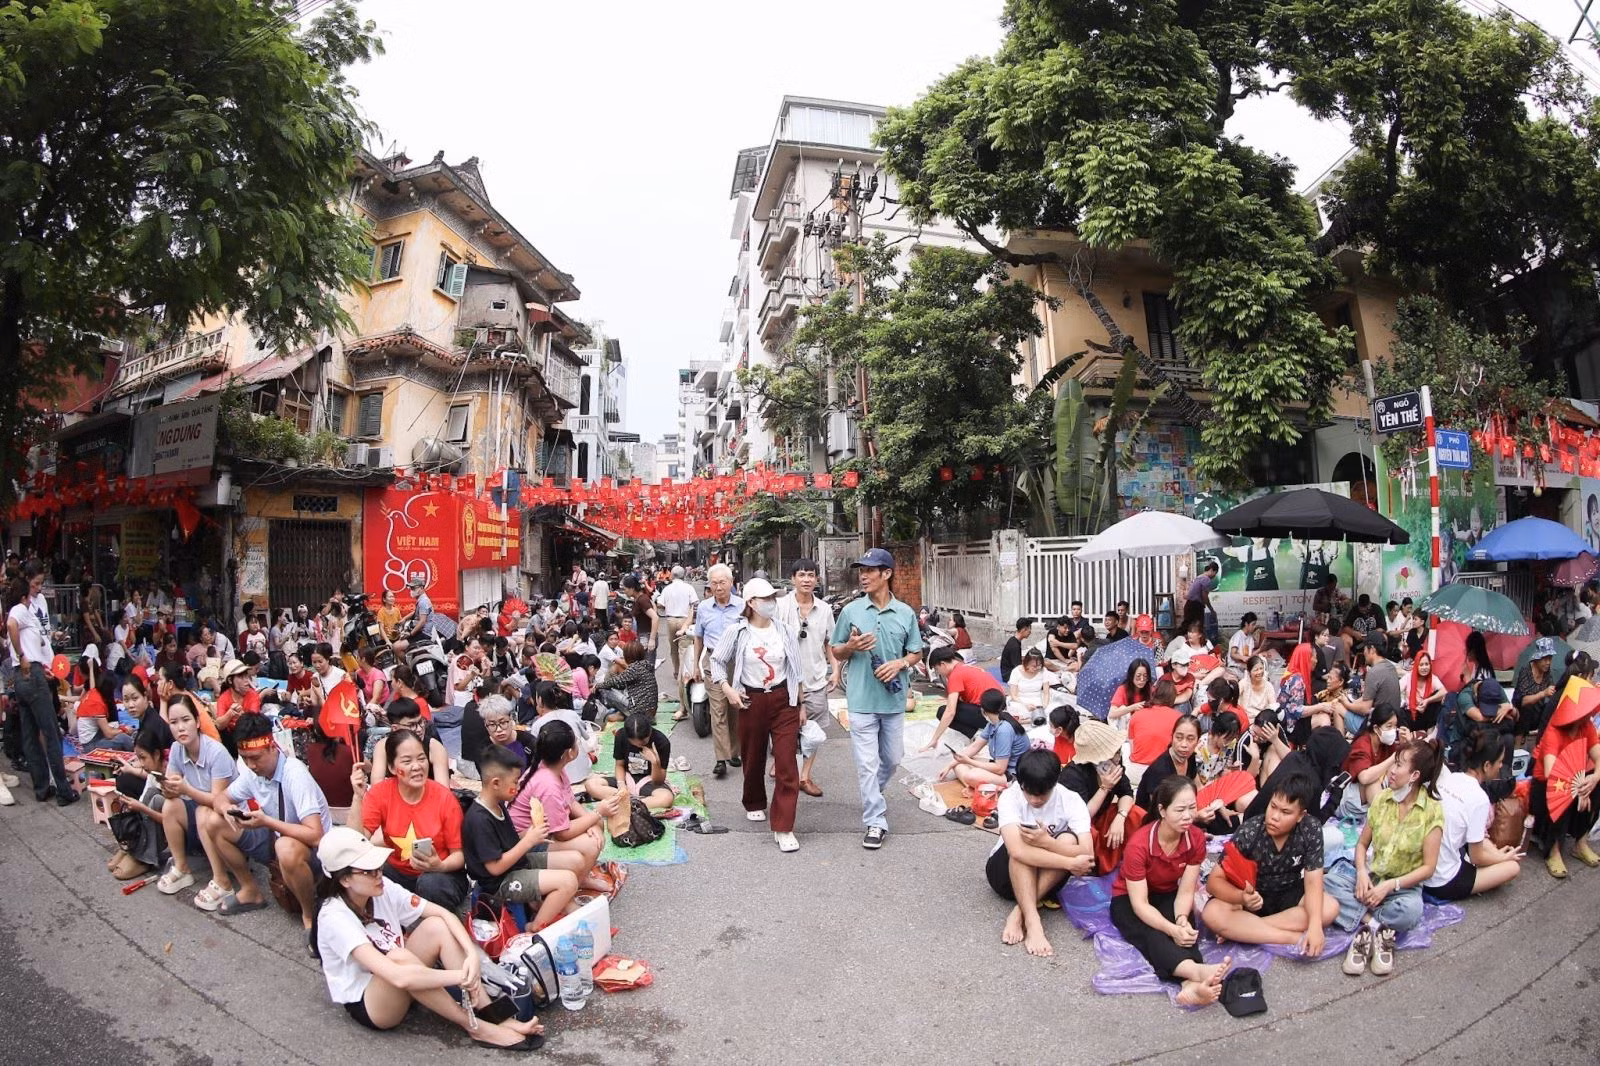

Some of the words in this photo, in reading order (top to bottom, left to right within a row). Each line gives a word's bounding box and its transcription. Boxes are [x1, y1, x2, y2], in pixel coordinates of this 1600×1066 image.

[1393, 397, 1409, 408] NGÕ
[1380, 411, 1399, 427] YÊN
[1400, 404, 1419, 423] THẾ
[396, 534, 416, 546] VIỆT
[418, 537, 439, 546] NAM
[1243, 596, 1284, 606] RESPECT
